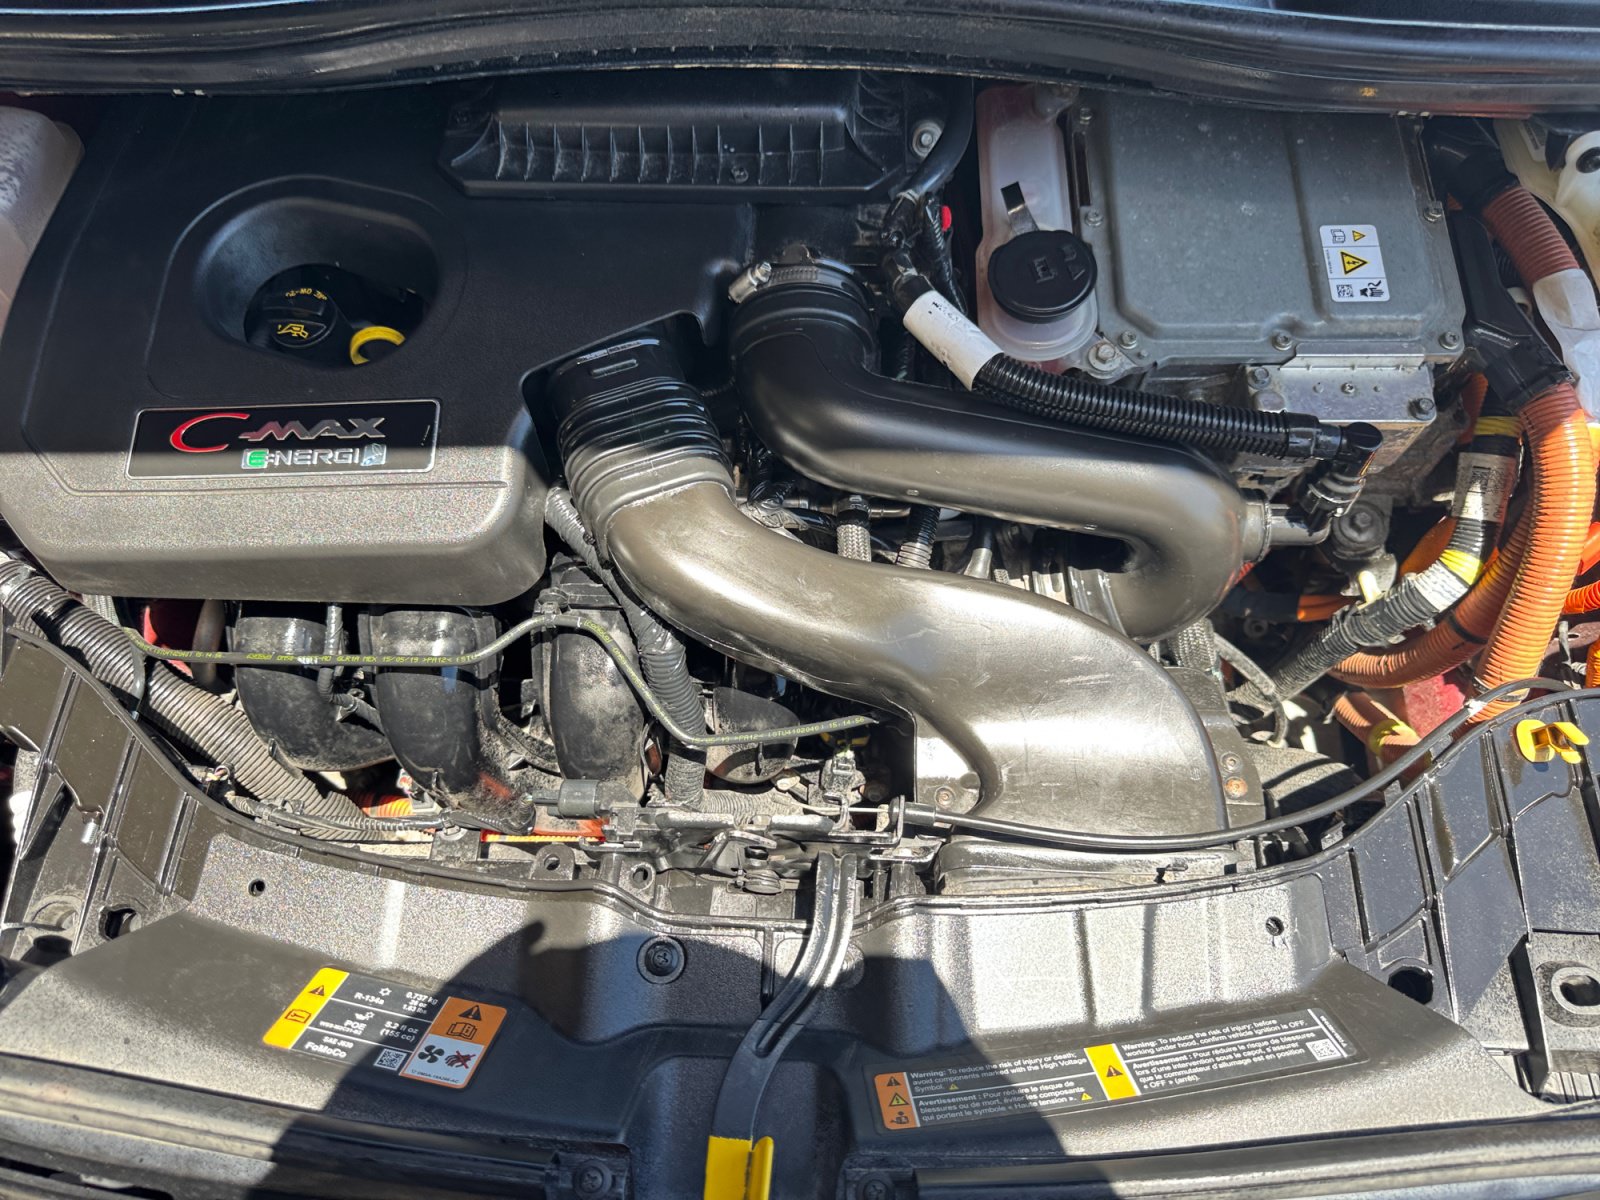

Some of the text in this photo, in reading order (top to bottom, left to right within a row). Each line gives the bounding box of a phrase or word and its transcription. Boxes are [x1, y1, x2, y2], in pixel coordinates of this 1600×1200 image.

[169, 412, 386, 453] C-MAX
[243, 446, 361, 470] ENERGI
[354, 992, 384, 1005] R-134a
[405, 991, 438, 1005] 0.737 kg
[343, 1019, 367, 1031] POE
[380, 1028, 415, 1042] (155 cc)
[384, 1021, 399, 1030] 5.2
[1121, 1041, 1158, 1051] Warning:
[1169, 1034, 1194, 1043] reduce
[1253, 1020, 1277, 1028] before
[304, 1041, 347, 1058] FoMoCo
[1125, 1048, 1155, 1057] working
[1156, 1044, 1177, 1052] under
[1200, 1035, 1227, 1044] confirm
[1228, 1030, 1253, 1039] vehicle
[1254, 1025, 1280, 1035] ignition
[1133, 1055, 1188, 1069] Avertissement
[1193, 1050, 1210, 1058] Pour
[1247, 1041, 1269, 1049] risque
[1280, 1032, 1315, 1042] blessures
[910, 1070, 946, 1079] Warning:
[959, 1065, 984, 1073] reduce
[1014, 1059, 1021, 1067] of
[1023, 1057, 1042, 1066] injury
[913, 1078, 933, 1086] avoid
[934, 1073, 980, 1084] components
[981, 1068, 1009, 1077] marked
[1010, 1066, 1026, 1074] with
[1040, 1061, 1058, 1070] High
[1059, 1057, 1087, 1067] Voltage
[1139, 1076, 1154, 1084] que
[1164, 1065, 1211, 1078] commutateur
[1276, 1048, 1304, 1059] position
[1172, 1057, 1214, 1069] intervention
[1215, 1054, 1233, 1062] sous
[918, 1095, 976, 1106] Avertissement
[983, 1091, 1001, 1099] Pour
[1040, 1083, 1063, 1092] risque
[1149, 1080, 1166, 1088] OFF
[920, 1104, 957, 1114] blessures
[1039, 1087, 1085, 1098] composants
[922, 1114, 935, 1122] qui
[936, 1111, 964, 1121] portent
[974, 1104, 1006, 1116] symbole
[1014, 1102, 1038, 1111] Haute
[1039, 1097, 1067, 1106] tension
